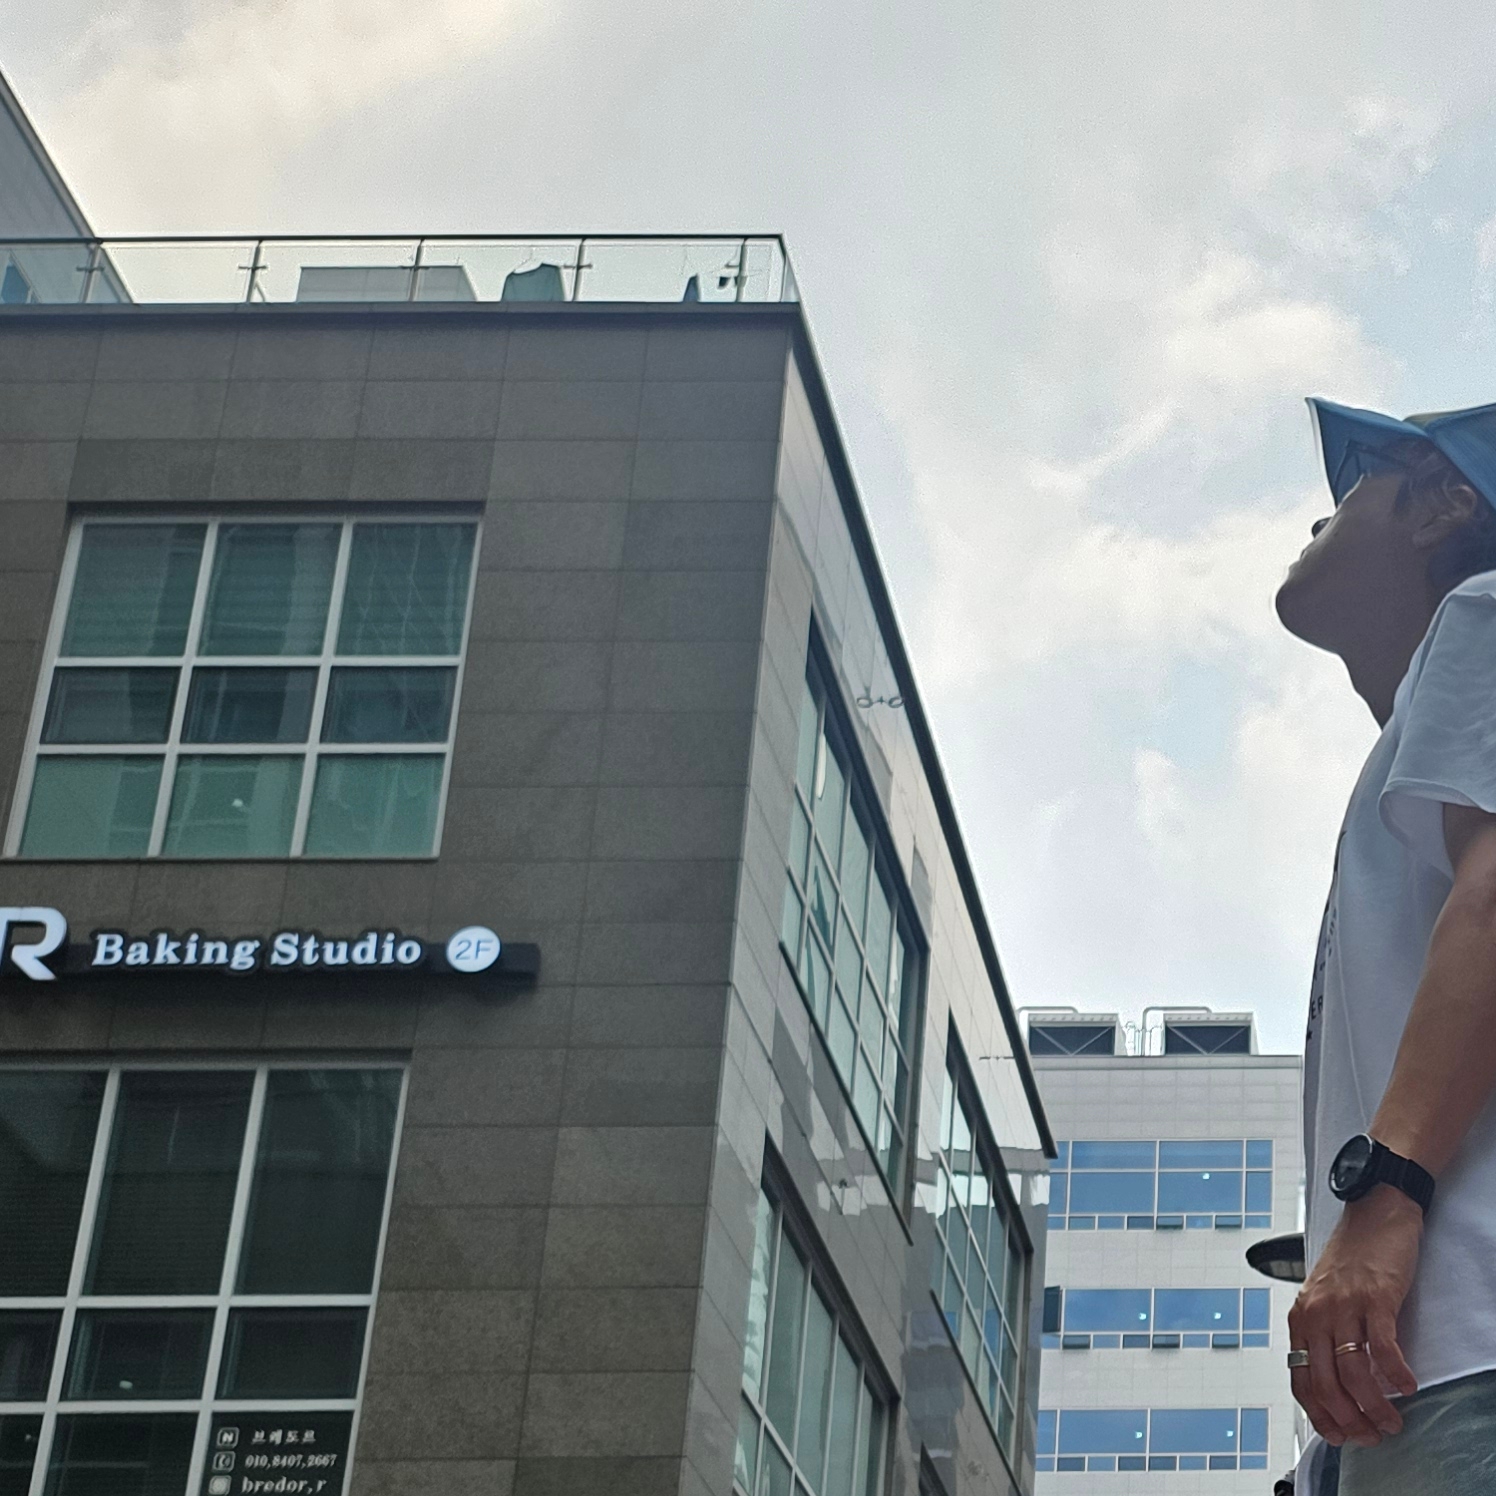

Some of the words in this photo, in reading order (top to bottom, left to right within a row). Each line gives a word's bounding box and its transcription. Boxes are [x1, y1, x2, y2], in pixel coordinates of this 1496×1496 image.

[91, 932, 260, 970] Baking
[270, 932, 422, 966] Studio
[455, 939, 493, 960] 2F
